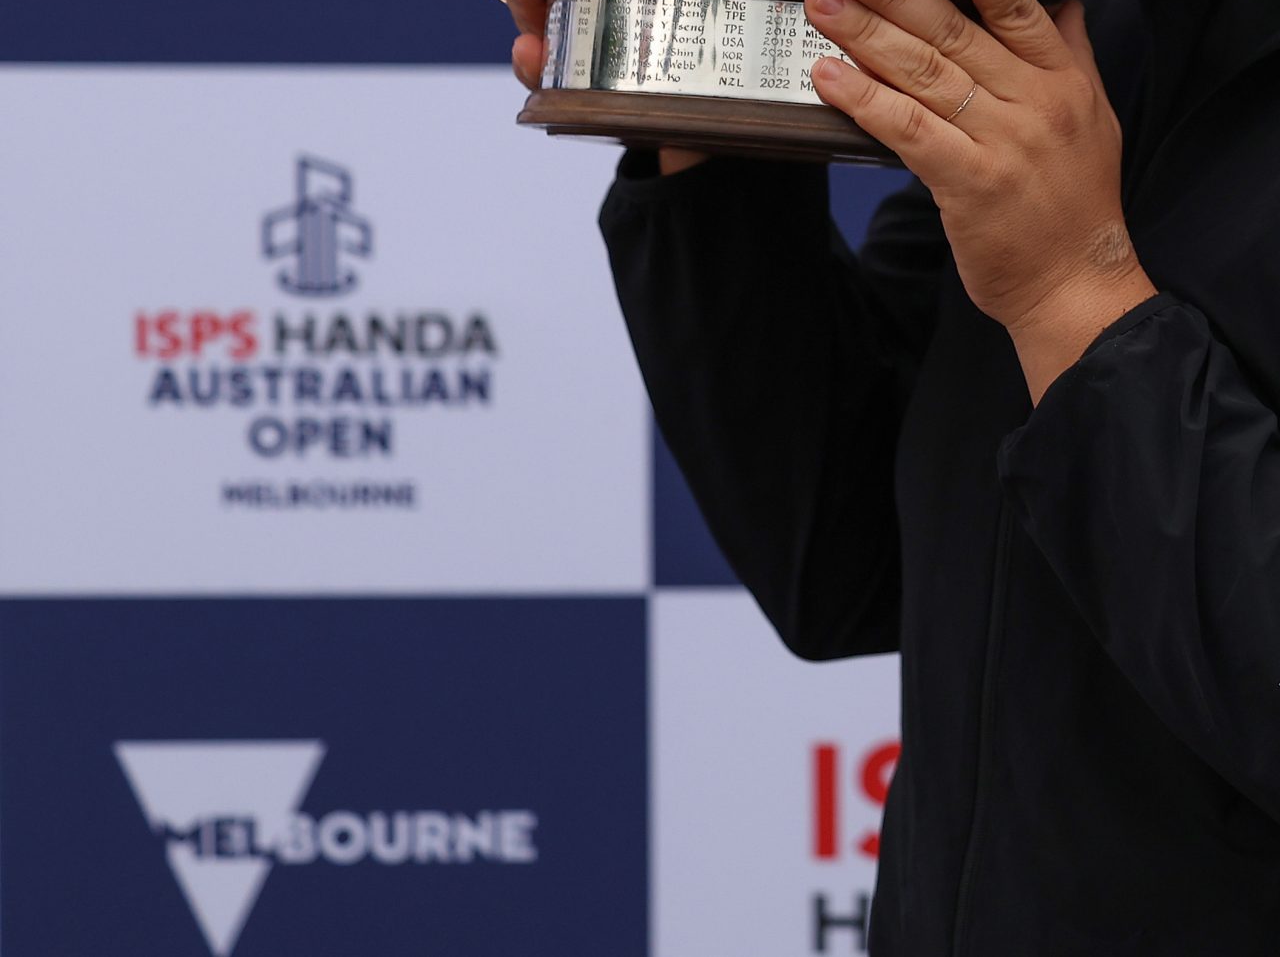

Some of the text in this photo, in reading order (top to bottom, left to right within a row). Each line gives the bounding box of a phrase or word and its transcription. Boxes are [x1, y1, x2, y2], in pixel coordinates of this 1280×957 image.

[724, 0, 746, 11] ENG
[767, 4, 797, 15] 2016
[637, 6, 656, 16] Miss
[725, 11, 746, 22] TPE
[766, 15, 797, 26] 2017
[635, 19, 654, 30] Miss
[724, 24, 744, 35] TPE
[766, 27, 797, 37] 2018
[634, 32, 654, 43] Miss
[722, 37, 744, 48] USA
[763, 37, 793, 48] 2019
[802, 39, 832, 51] Miss
[722, 51, 743, 61] KOR
[761, 48, 792, 58] 2020
[720, 62, 742, 74] AUS
[761, 65, 790, 76] 2021
[631, 70, 652, 81] Miss
[667, 73, 682, 83] Ko
[718, 77, 744, 88] NZL
[760, 78, 791, 89] 2022
[134, 310, 497, 360] ISPS HANDA
[149, 366, 491, 408] AUSTRALIAN
[247, 416, 393, 458] OPEN
[220, 479, 417, 509] MELBOURNE
[152, 809, 538, 864] MELBOURNE
